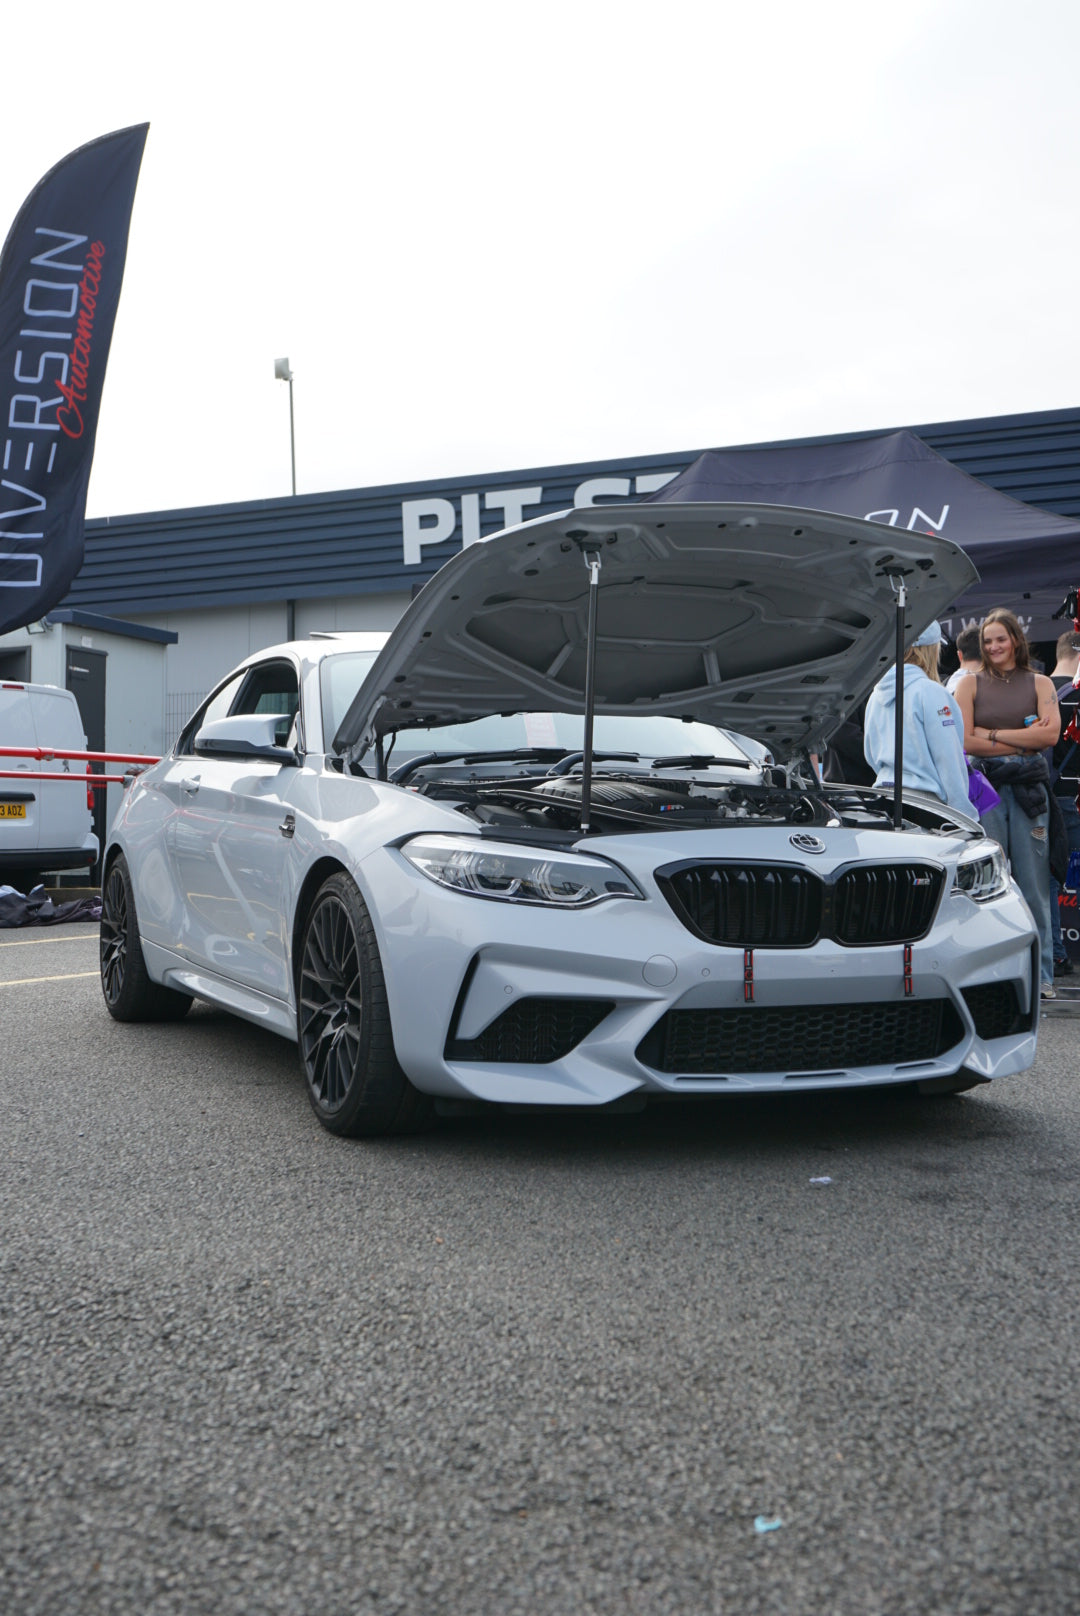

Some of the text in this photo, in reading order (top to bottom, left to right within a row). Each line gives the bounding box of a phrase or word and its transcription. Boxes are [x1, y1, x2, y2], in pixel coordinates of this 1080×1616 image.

[56, 240, 105, 439] Automotive
[402, 486, 543, 566] PIT
[8, 805, 23, 817] AOZ
